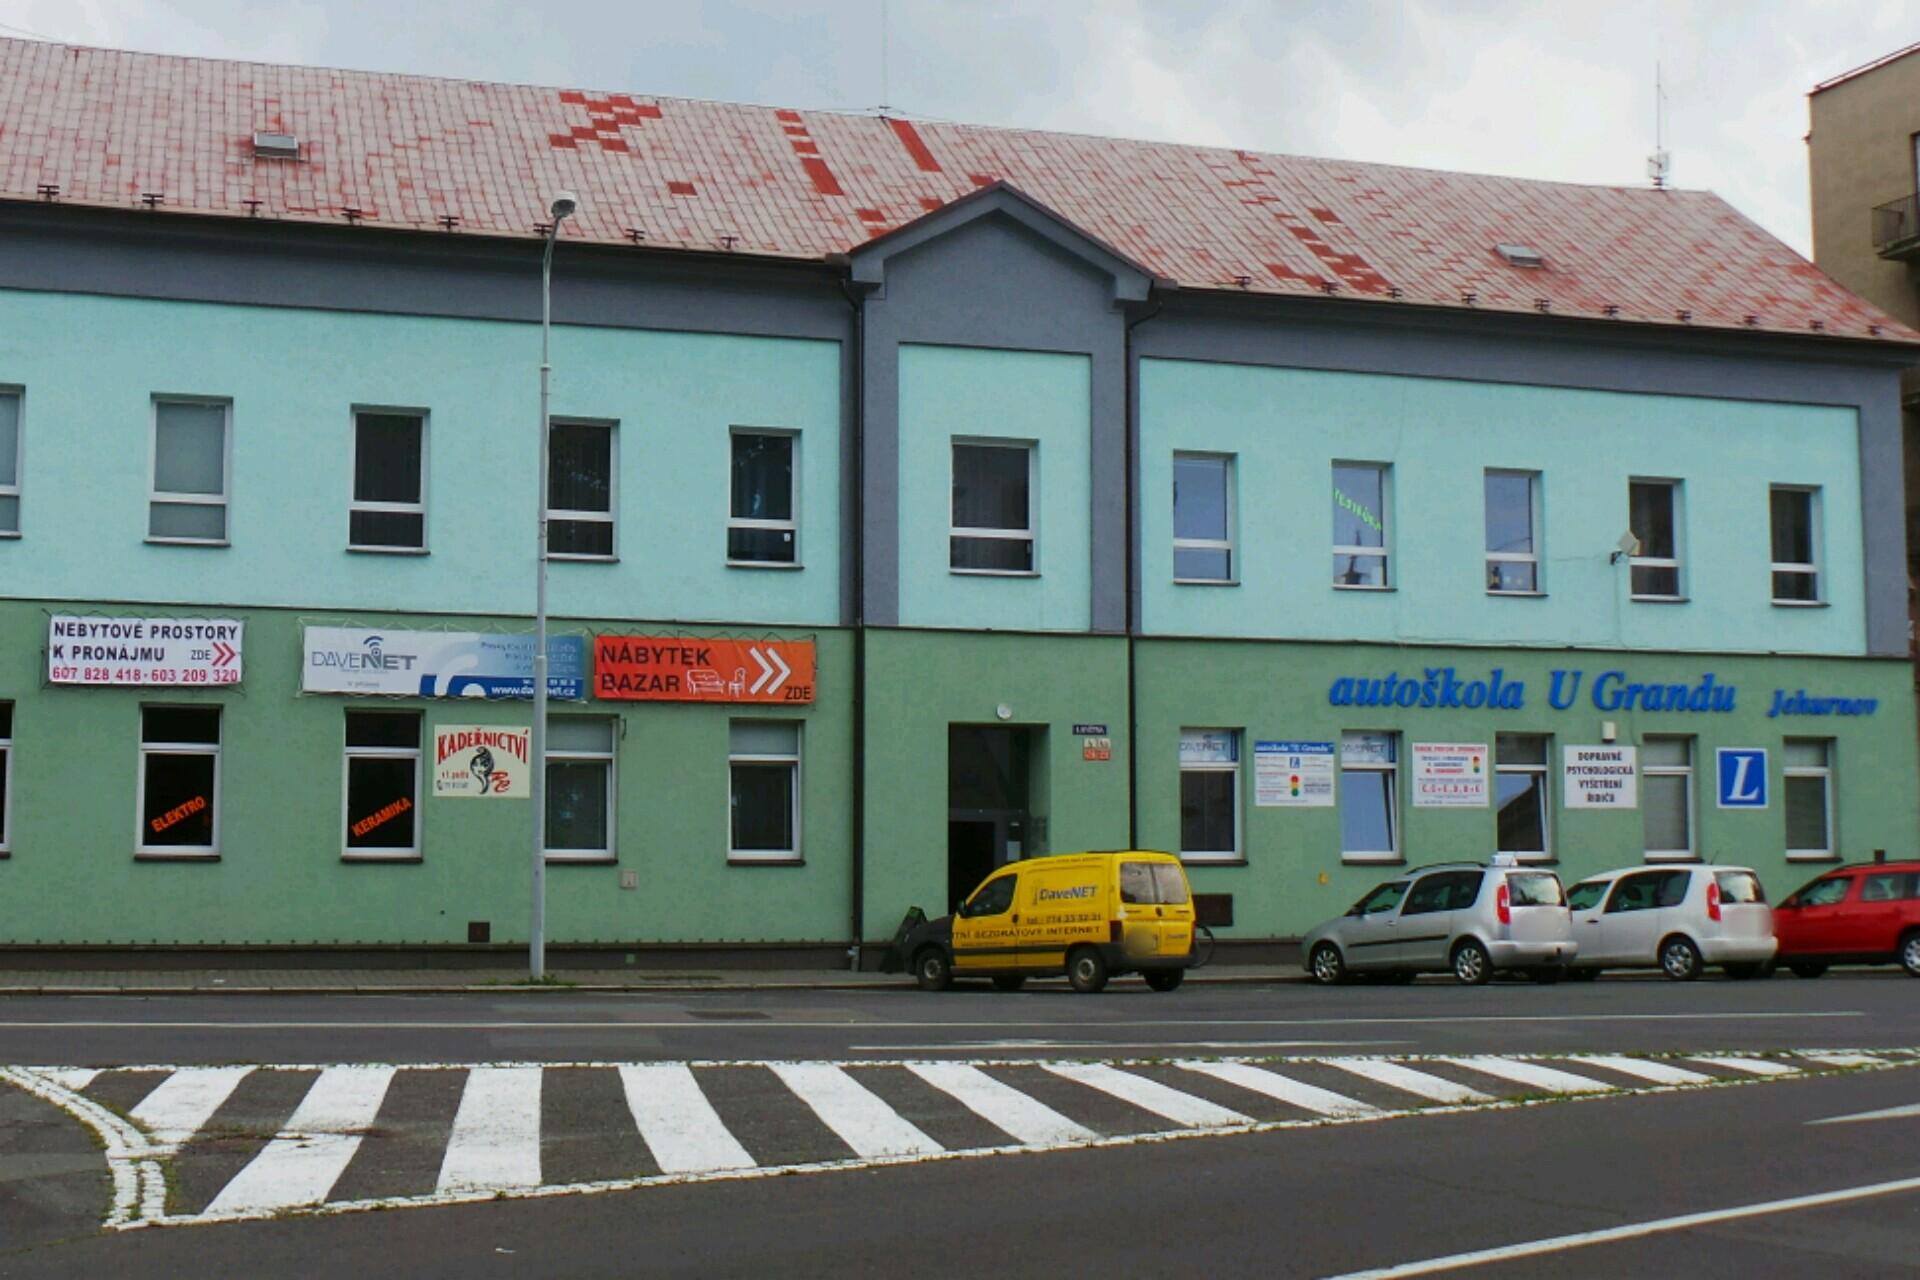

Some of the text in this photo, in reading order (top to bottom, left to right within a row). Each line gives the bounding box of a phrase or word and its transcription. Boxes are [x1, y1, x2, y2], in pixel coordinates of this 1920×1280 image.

[54, 621, 238, 640] NEBYTOVÉ PROSTORY
[53, 643, 211, 662] K PRONÁJMU ZDE
[311, 650, 417, 670] DAVENET
[601, 643, 711, 666] NÁBYTEK
[52, 667, 78, 679] 607
[84, 667, 109, 680] 828
[182, 669, 207, 682] 209
[213, 669, 238, 682] 320
[602, 673, 811, 700] BAZAR ZDE
[1329, 667, 1524, 709] autoškola
[1548, 670, 1583, 710] U
[1592, 671, 1736, 712] Grandu
[438, 727, 528, 765] KADEŘNICTVÍ
[1727, 756, 1760, 800] L
[151, 796, 206, 832] ELEKTRO
[351, 797, 412, 837] KERAMIKA
[1039, 884, 1098, 900] DaveNET
[1047, 926, 1100, 935] INTERNET
